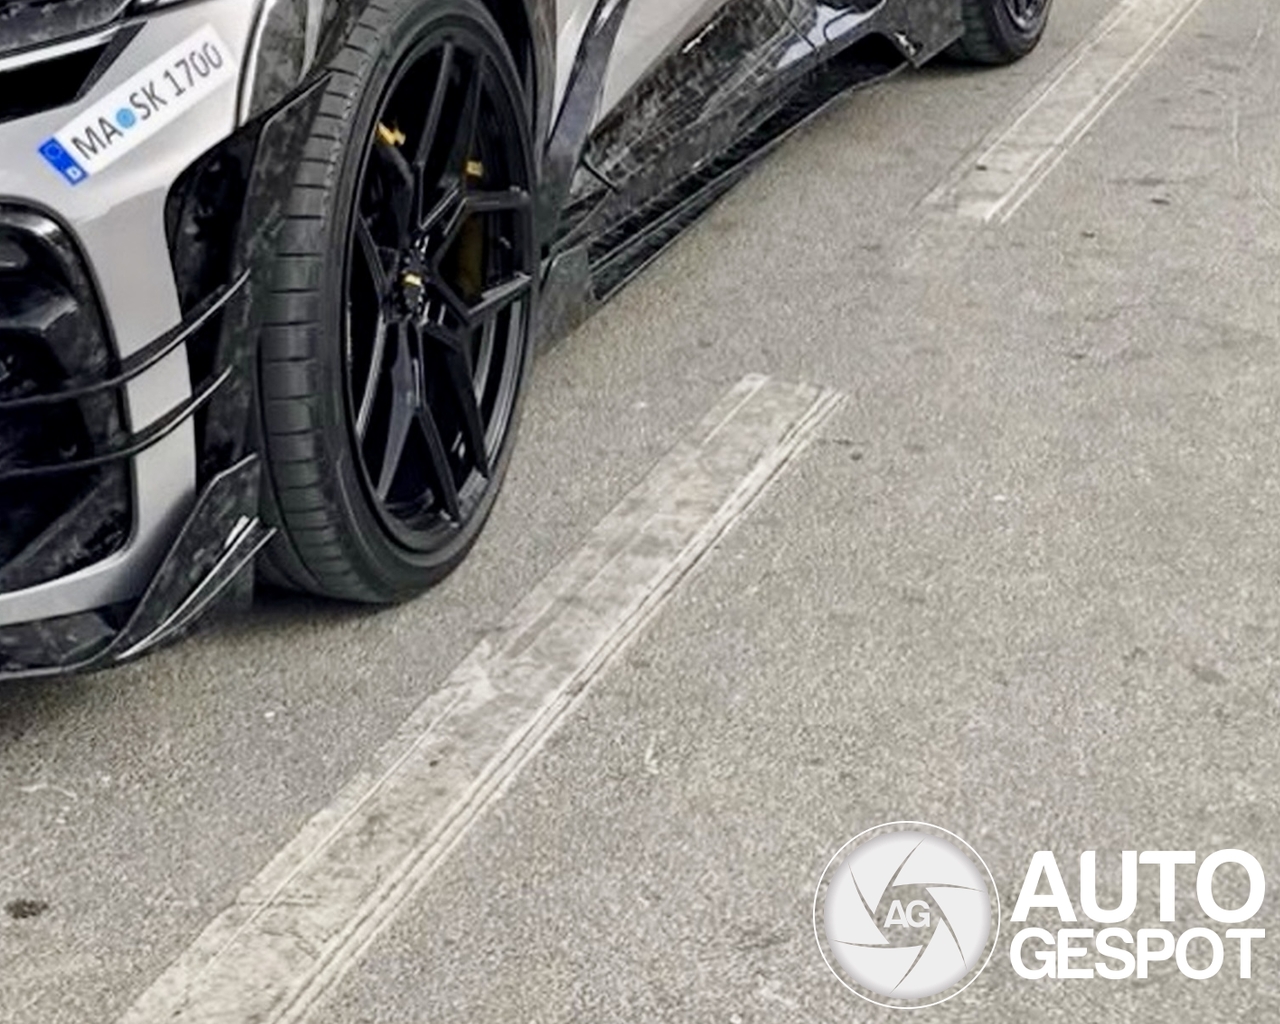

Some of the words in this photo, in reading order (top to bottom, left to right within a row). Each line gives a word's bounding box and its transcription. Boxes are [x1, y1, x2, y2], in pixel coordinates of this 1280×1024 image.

[71, 117, 123, 160] MA
[129, 81, 168, 120] SK
[163, 42, 223, 97] 1700
